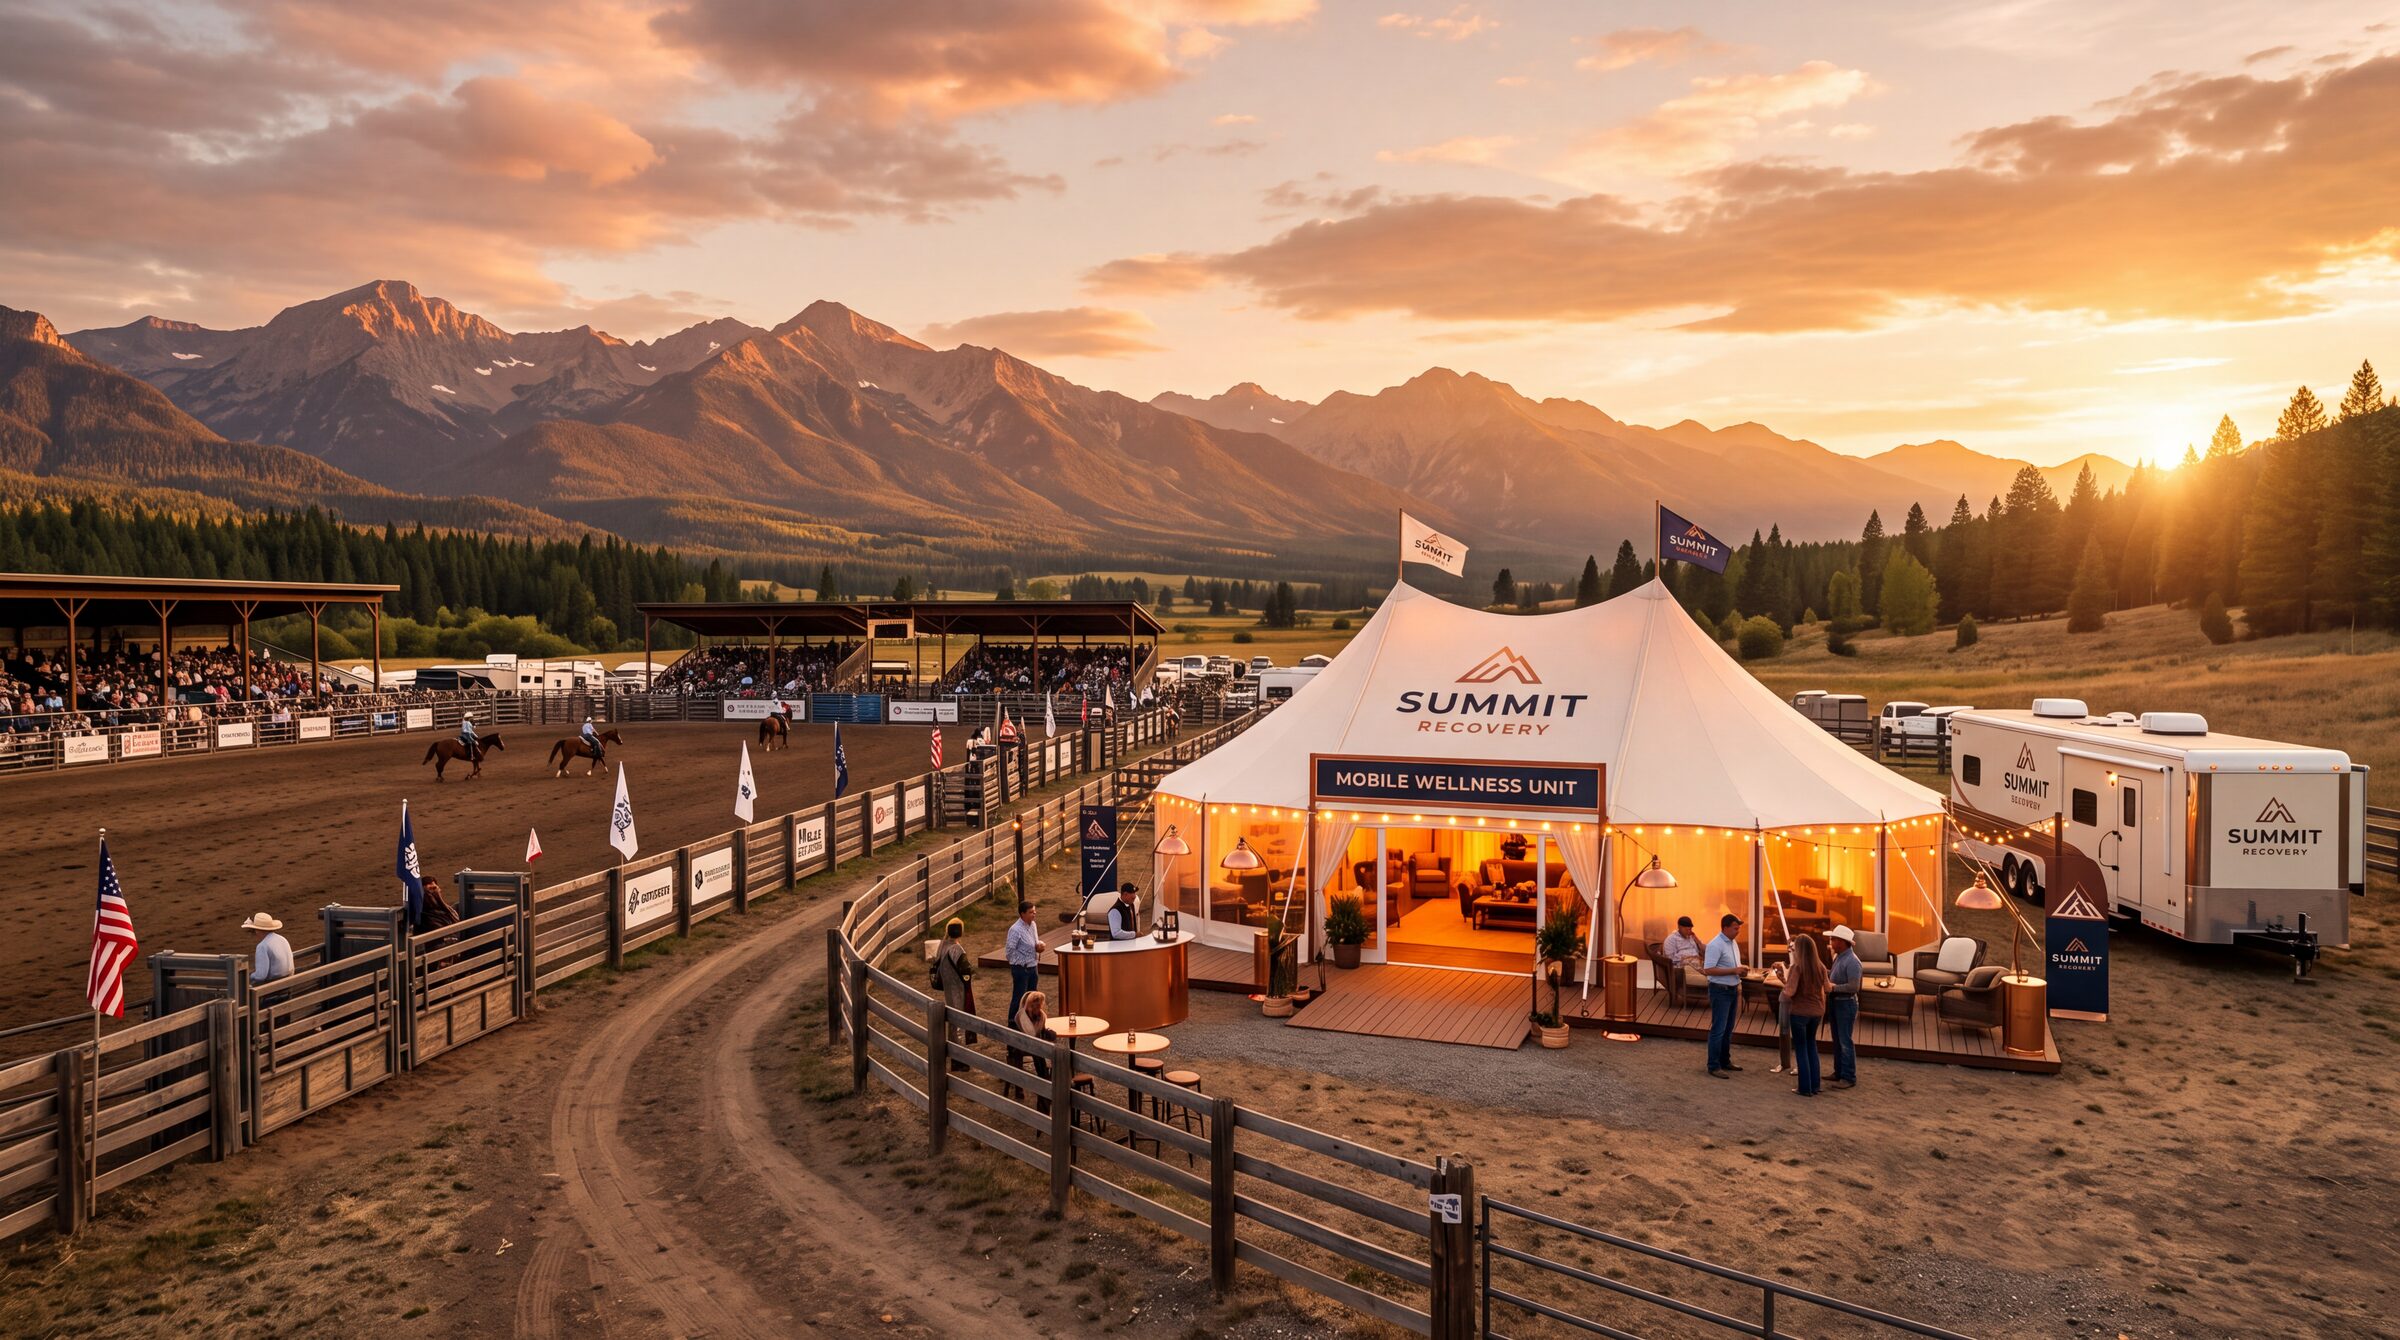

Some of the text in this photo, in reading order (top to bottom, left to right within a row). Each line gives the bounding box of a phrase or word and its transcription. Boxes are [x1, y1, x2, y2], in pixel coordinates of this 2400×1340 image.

[1396, 691, 1588, 718] SUMMIT
[1417, 720, 1550, 736] RECOVERY
[1336, 771, 1578, 796] MOBILE WELLNESS UNIT
[2004, 771, 2050, 799] SUMMIT
[2228, 828, 2323, 844] SUMMIT
[2242, 848, 2308, 856] RECOVERY
[2052, 953, 2103, 965] SUMMIT
